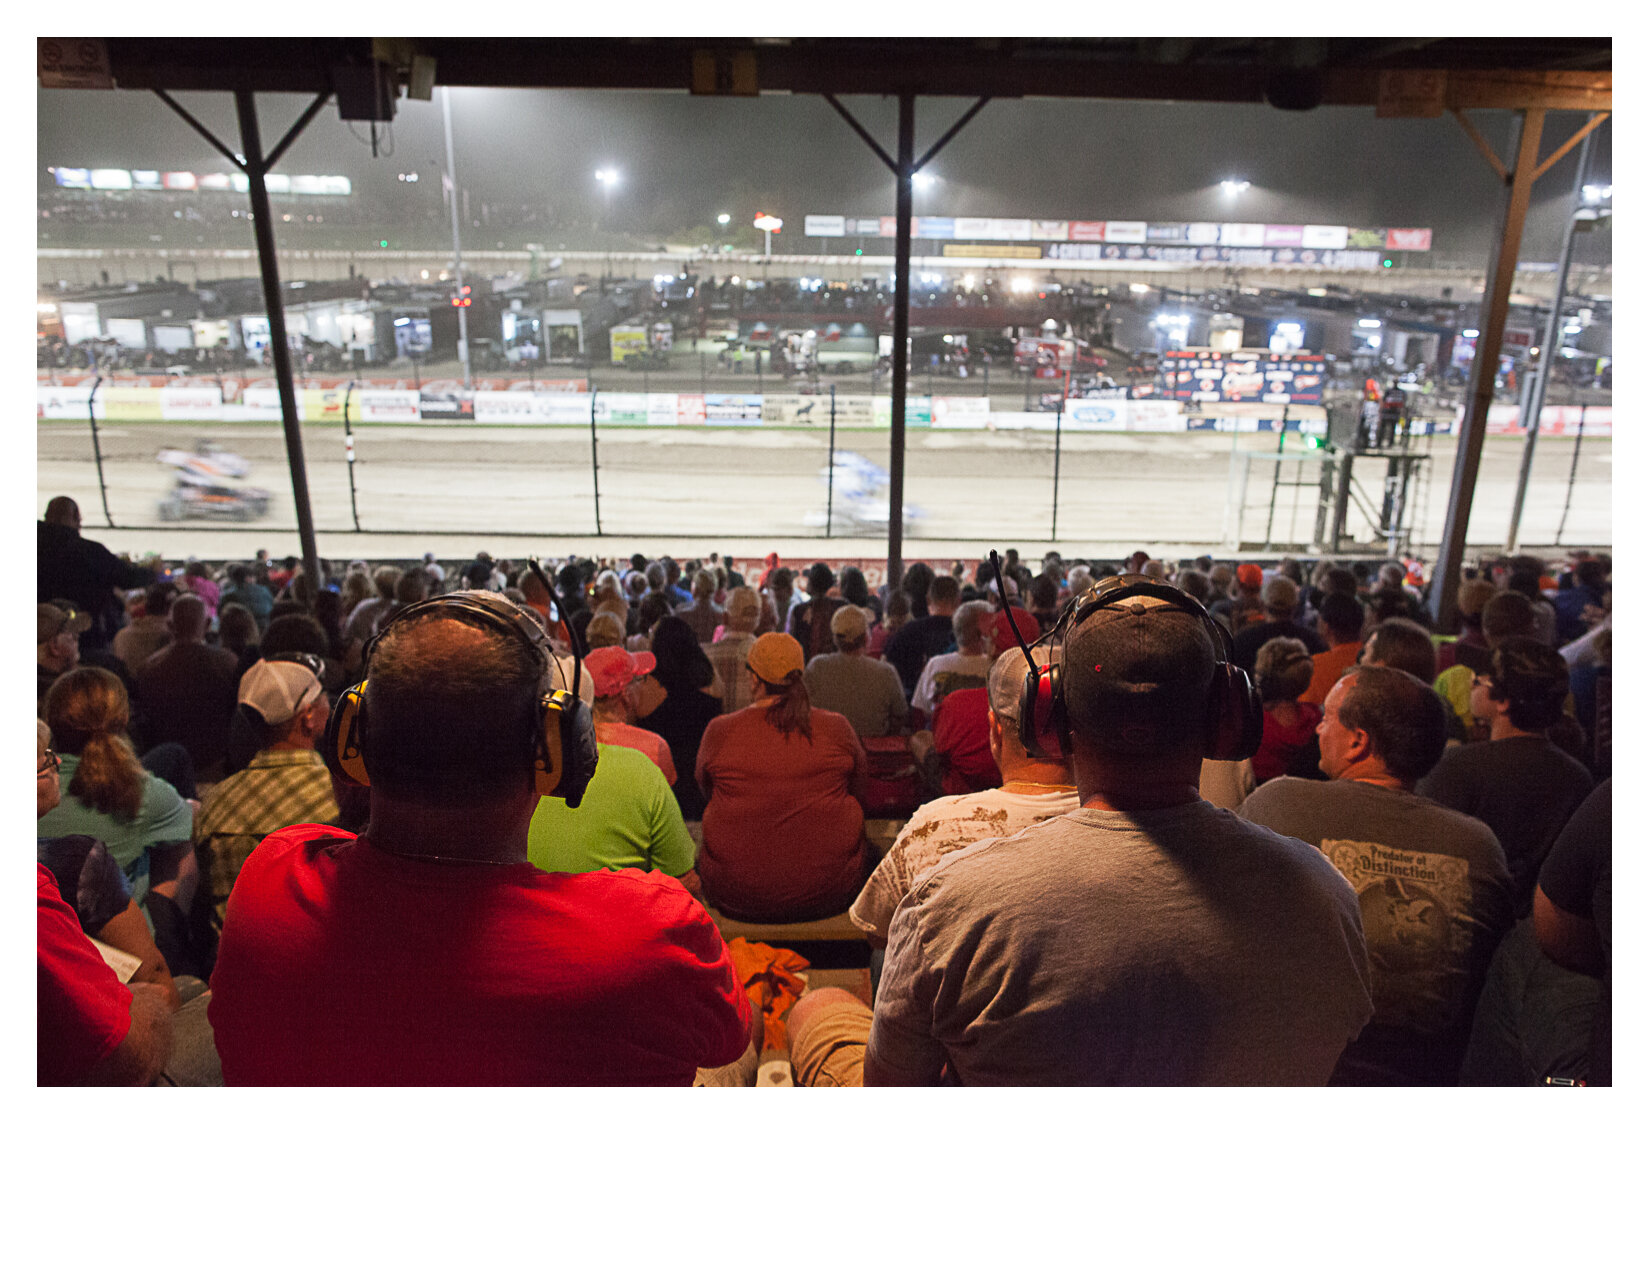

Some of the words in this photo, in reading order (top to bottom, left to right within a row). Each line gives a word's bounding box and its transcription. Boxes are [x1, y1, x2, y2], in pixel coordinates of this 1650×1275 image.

[1370, 845, 1414, 864] Predator
[1416, 856, 1427, 866] of
[1359, 855, 1436, 880] Distinction
